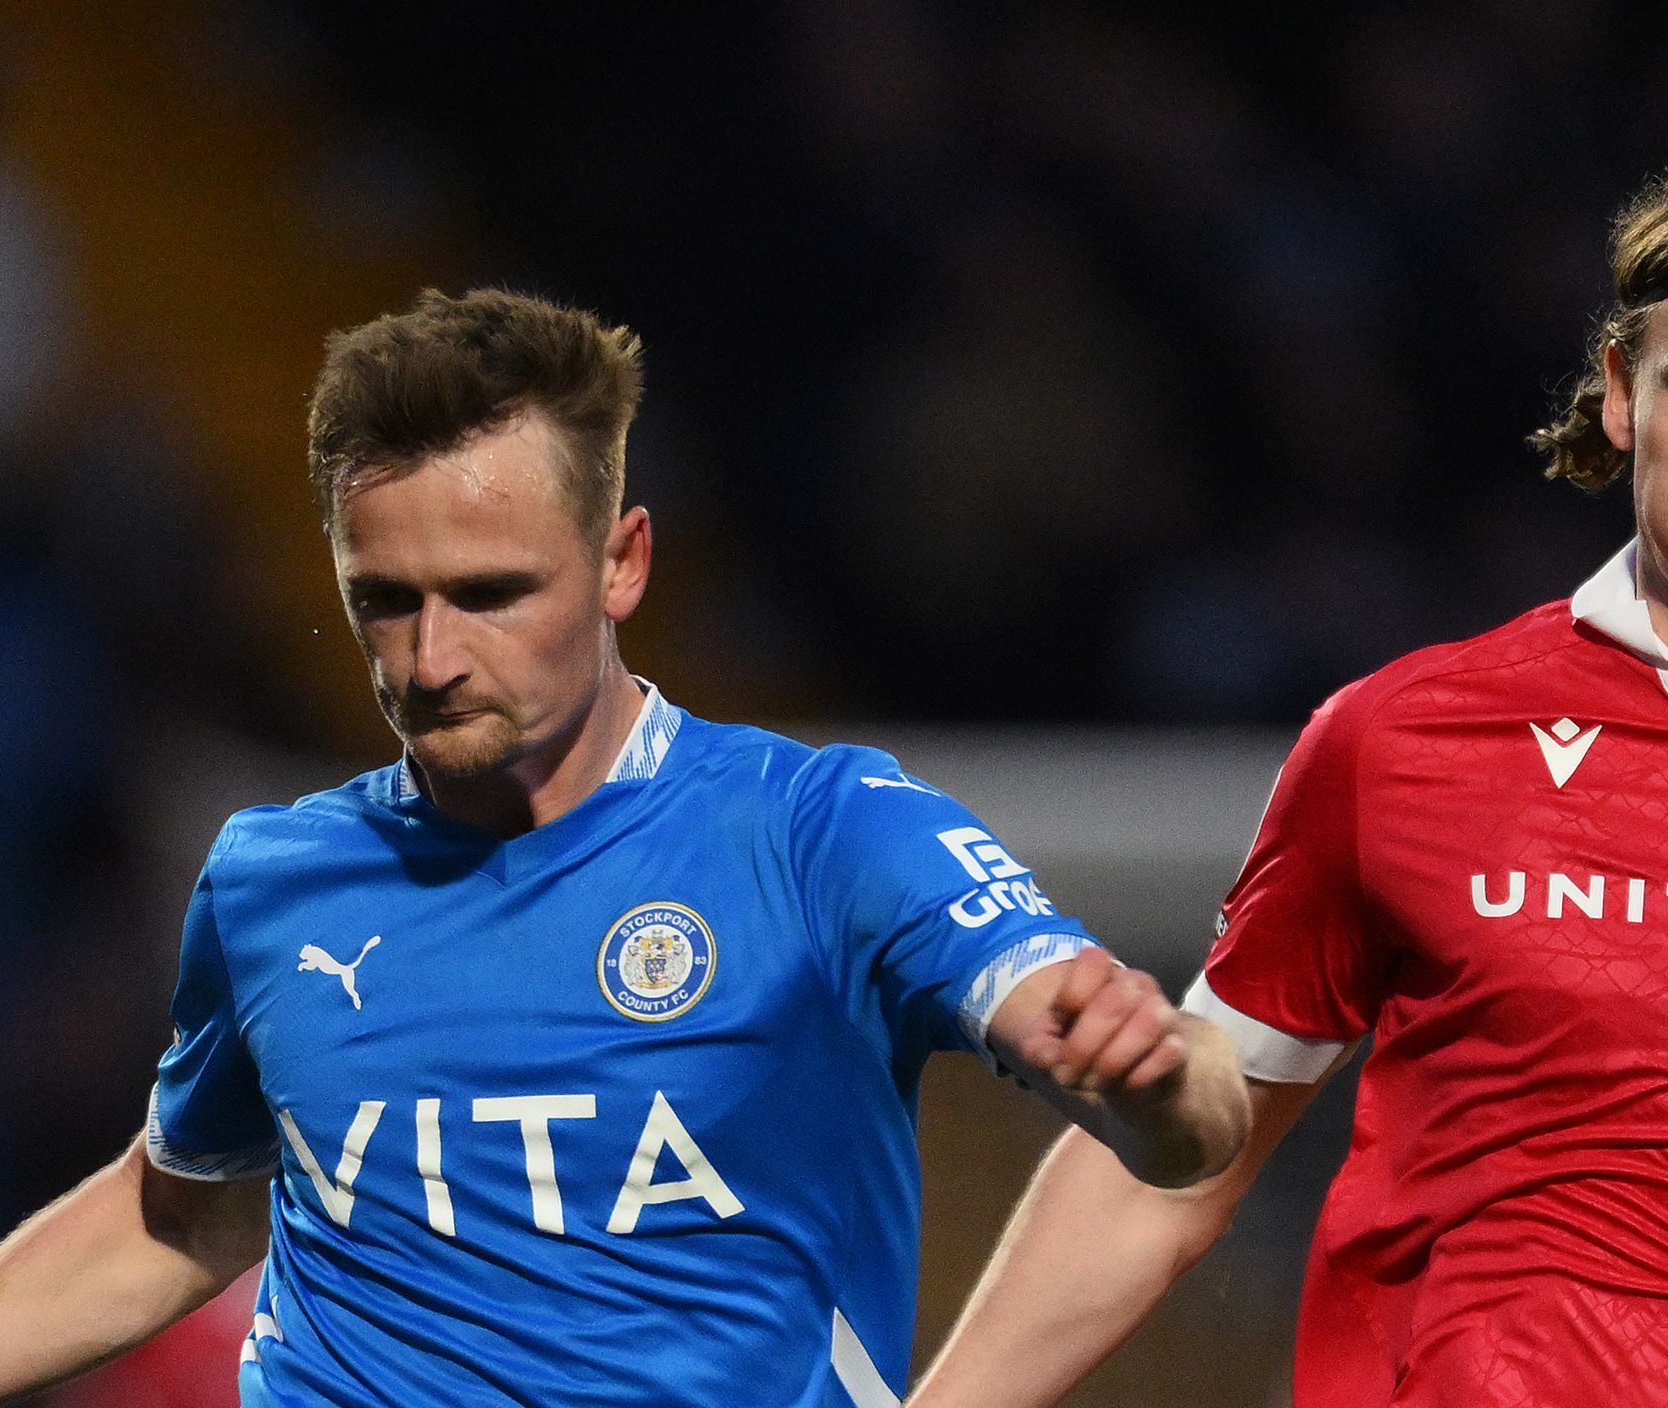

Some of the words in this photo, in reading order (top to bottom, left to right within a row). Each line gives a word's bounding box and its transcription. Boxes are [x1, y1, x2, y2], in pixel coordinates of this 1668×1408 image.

[620, 912, 697, 938] STOCKPORT
[607, 958, 617, 968] 18
[695, 956, 707, 966] 83
[617, 991, 669, 1012] COUNTY
[670, 989, 689, 1005] FC
[278, 1089, 746, 1237] VITA
